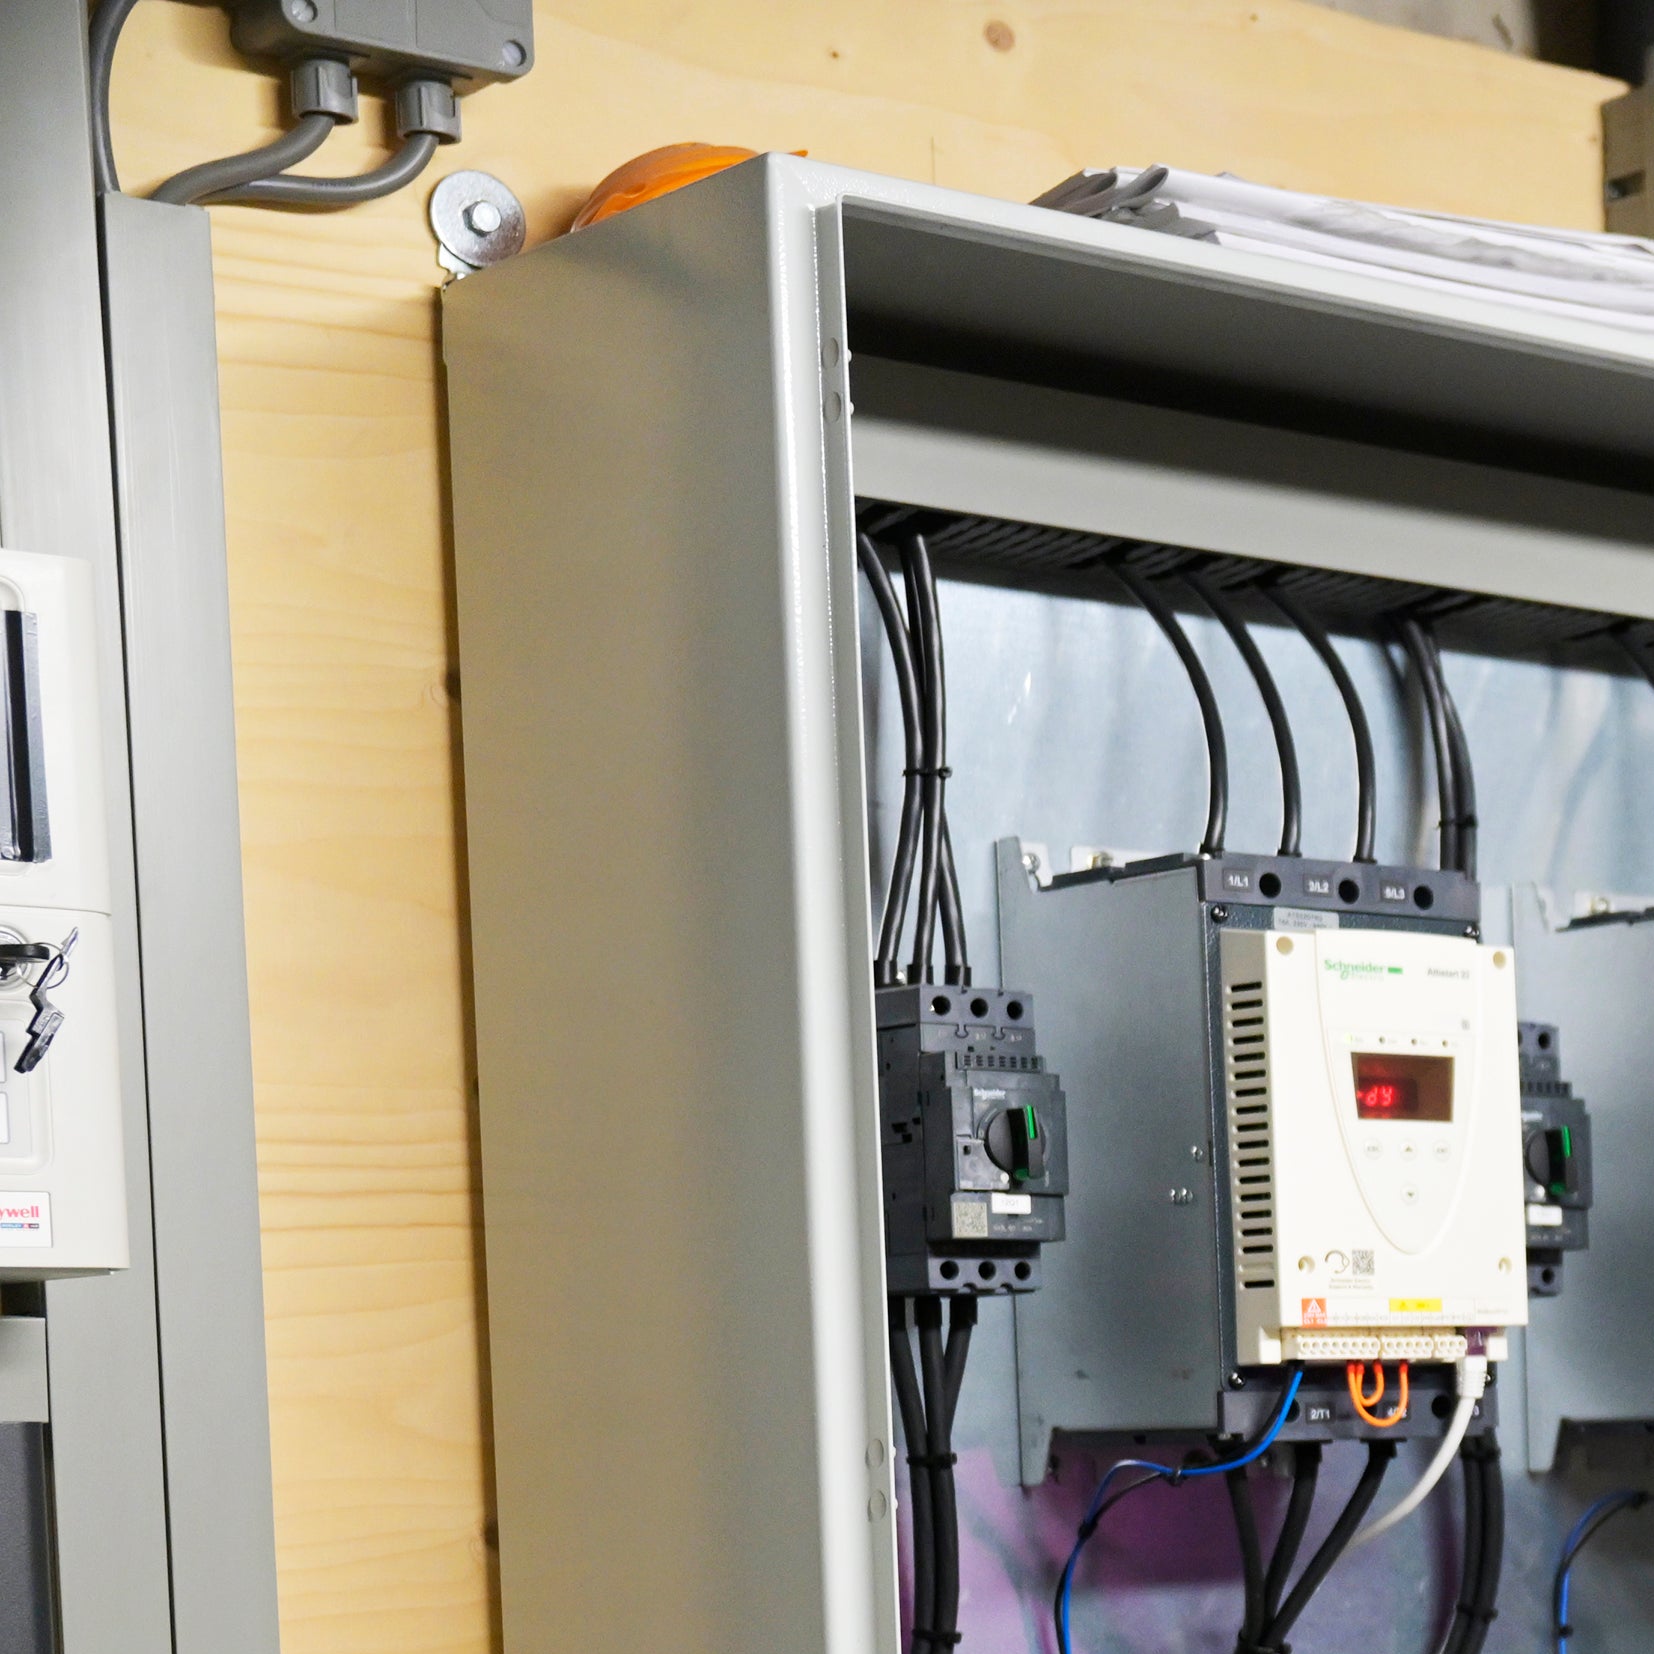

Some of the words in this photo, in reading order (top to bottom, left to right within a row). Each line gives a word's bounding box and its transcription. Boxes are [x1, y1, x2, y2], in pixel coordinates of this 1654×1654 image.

[1228, 875, 1249, 888] 1/L1
[1324, 959, 1384, 980] Schneider
[1310, 1408, 1331, 1420] 2/T1
